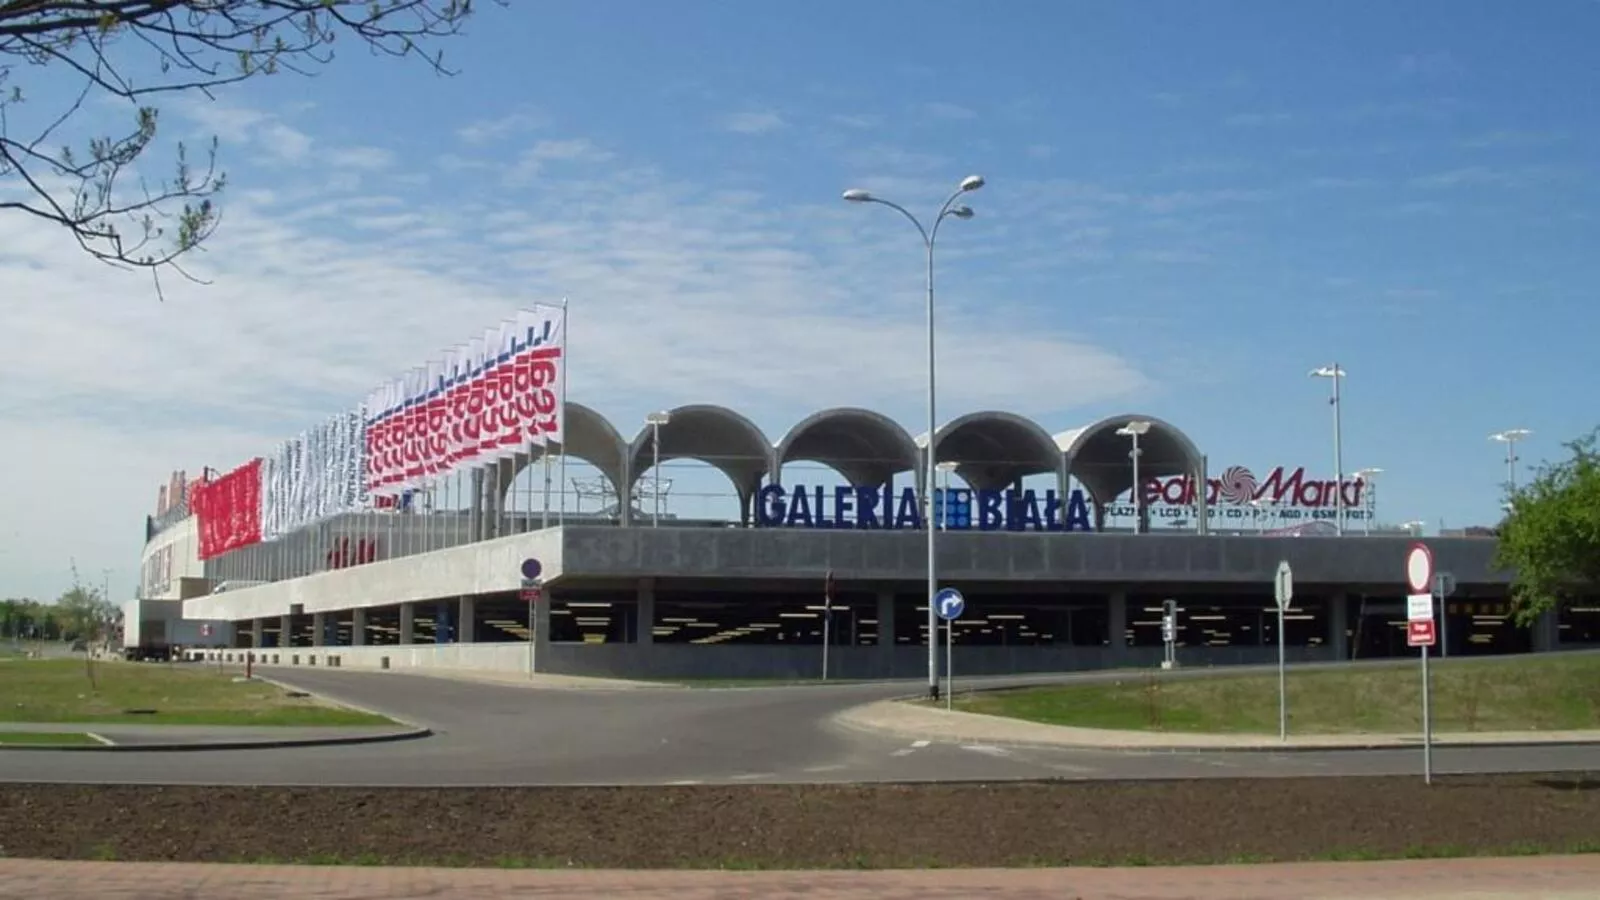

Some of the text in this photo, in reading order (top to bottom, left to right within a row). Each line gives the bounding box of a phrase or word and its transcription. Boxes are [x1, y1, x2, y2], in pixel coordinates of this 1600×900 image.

[1251, 466, 1364, 506] Markt
[759, 484, 1090, 531] GALERIA BIAŁA
[1160, 507, 1181, 517] LCD
[1226, 509, 1241, 518] CD
